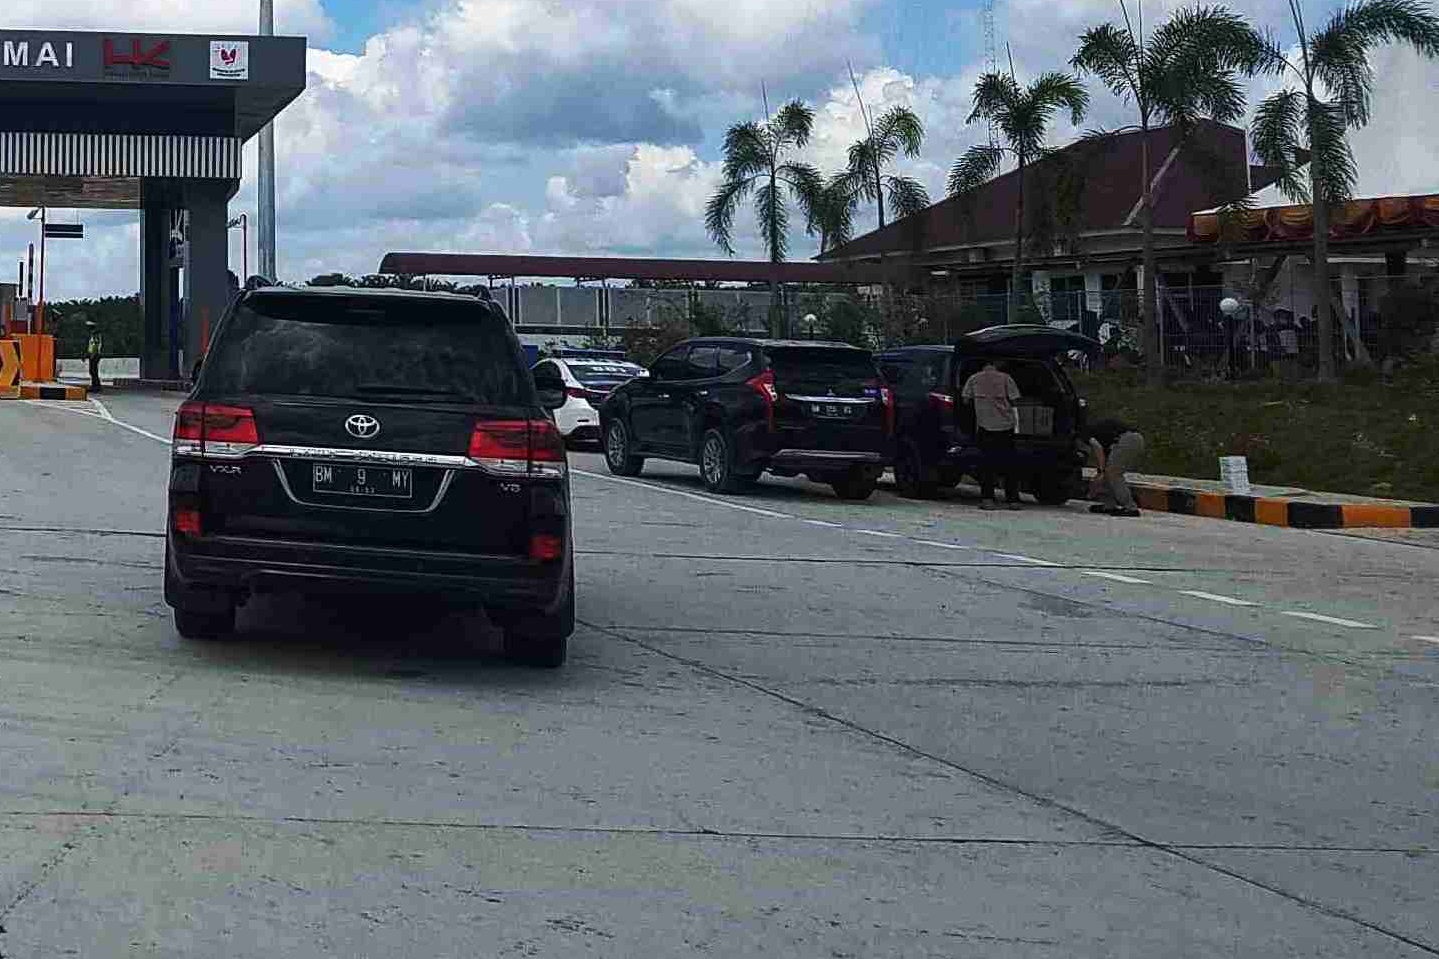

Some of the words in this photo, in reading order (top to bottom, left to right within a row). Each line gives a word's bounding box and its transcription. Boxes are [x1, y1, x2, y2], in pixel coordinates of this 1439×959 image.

[315, 465, 333, 483] BM
[356, 468, 367, 486] 9
[392, 471, 410, 488] MY
